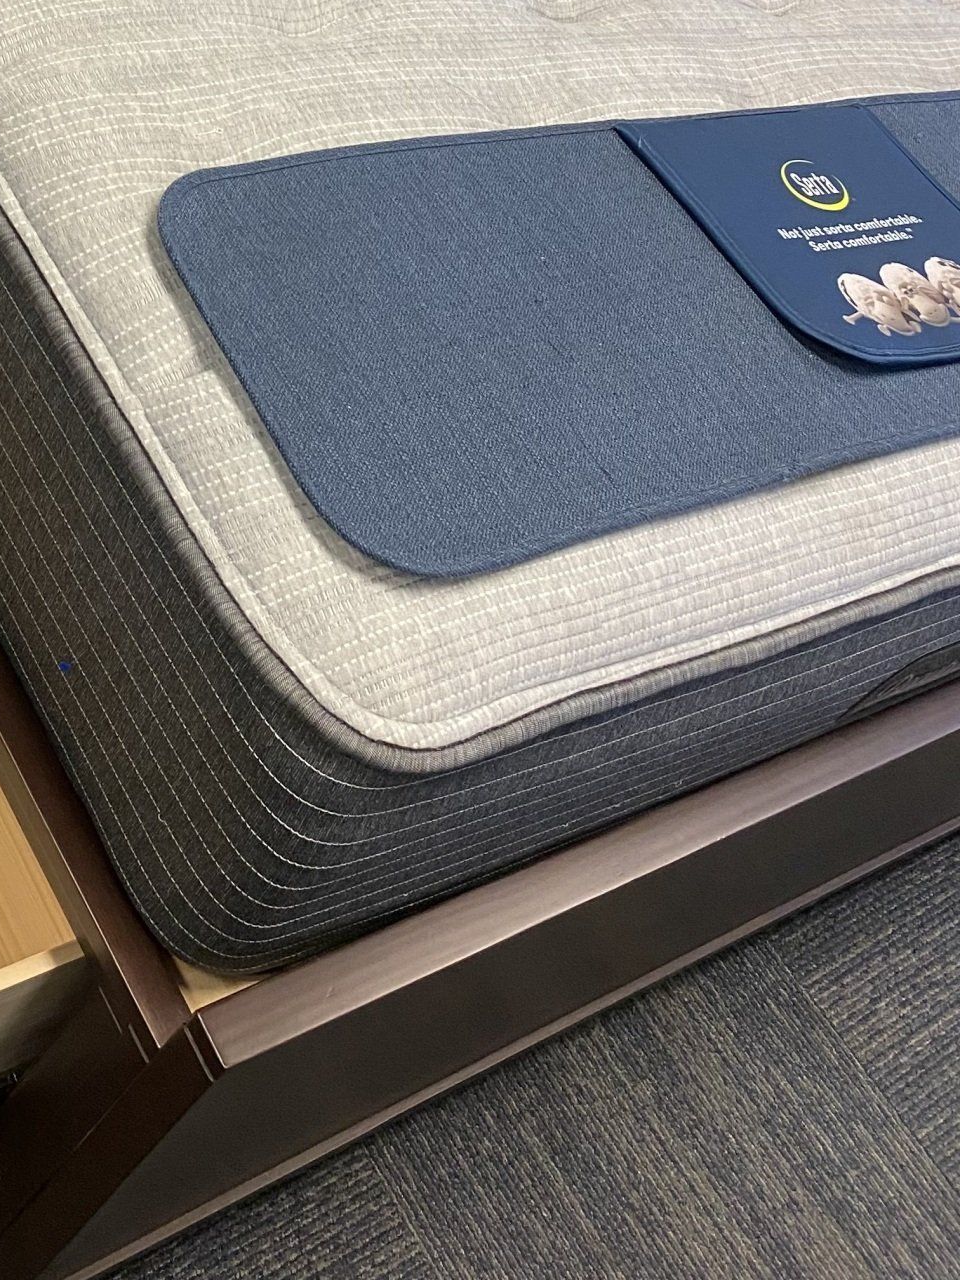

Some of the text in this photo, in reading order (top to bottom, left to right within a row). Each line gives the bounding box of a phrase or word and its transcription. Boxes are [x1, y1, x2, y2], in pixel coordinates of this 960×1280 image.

[790, 172, 840, 197] Serta
[777, 213, 923, 240] Not just sorta comfortable.
[809, 238, 841, 252] Serta
